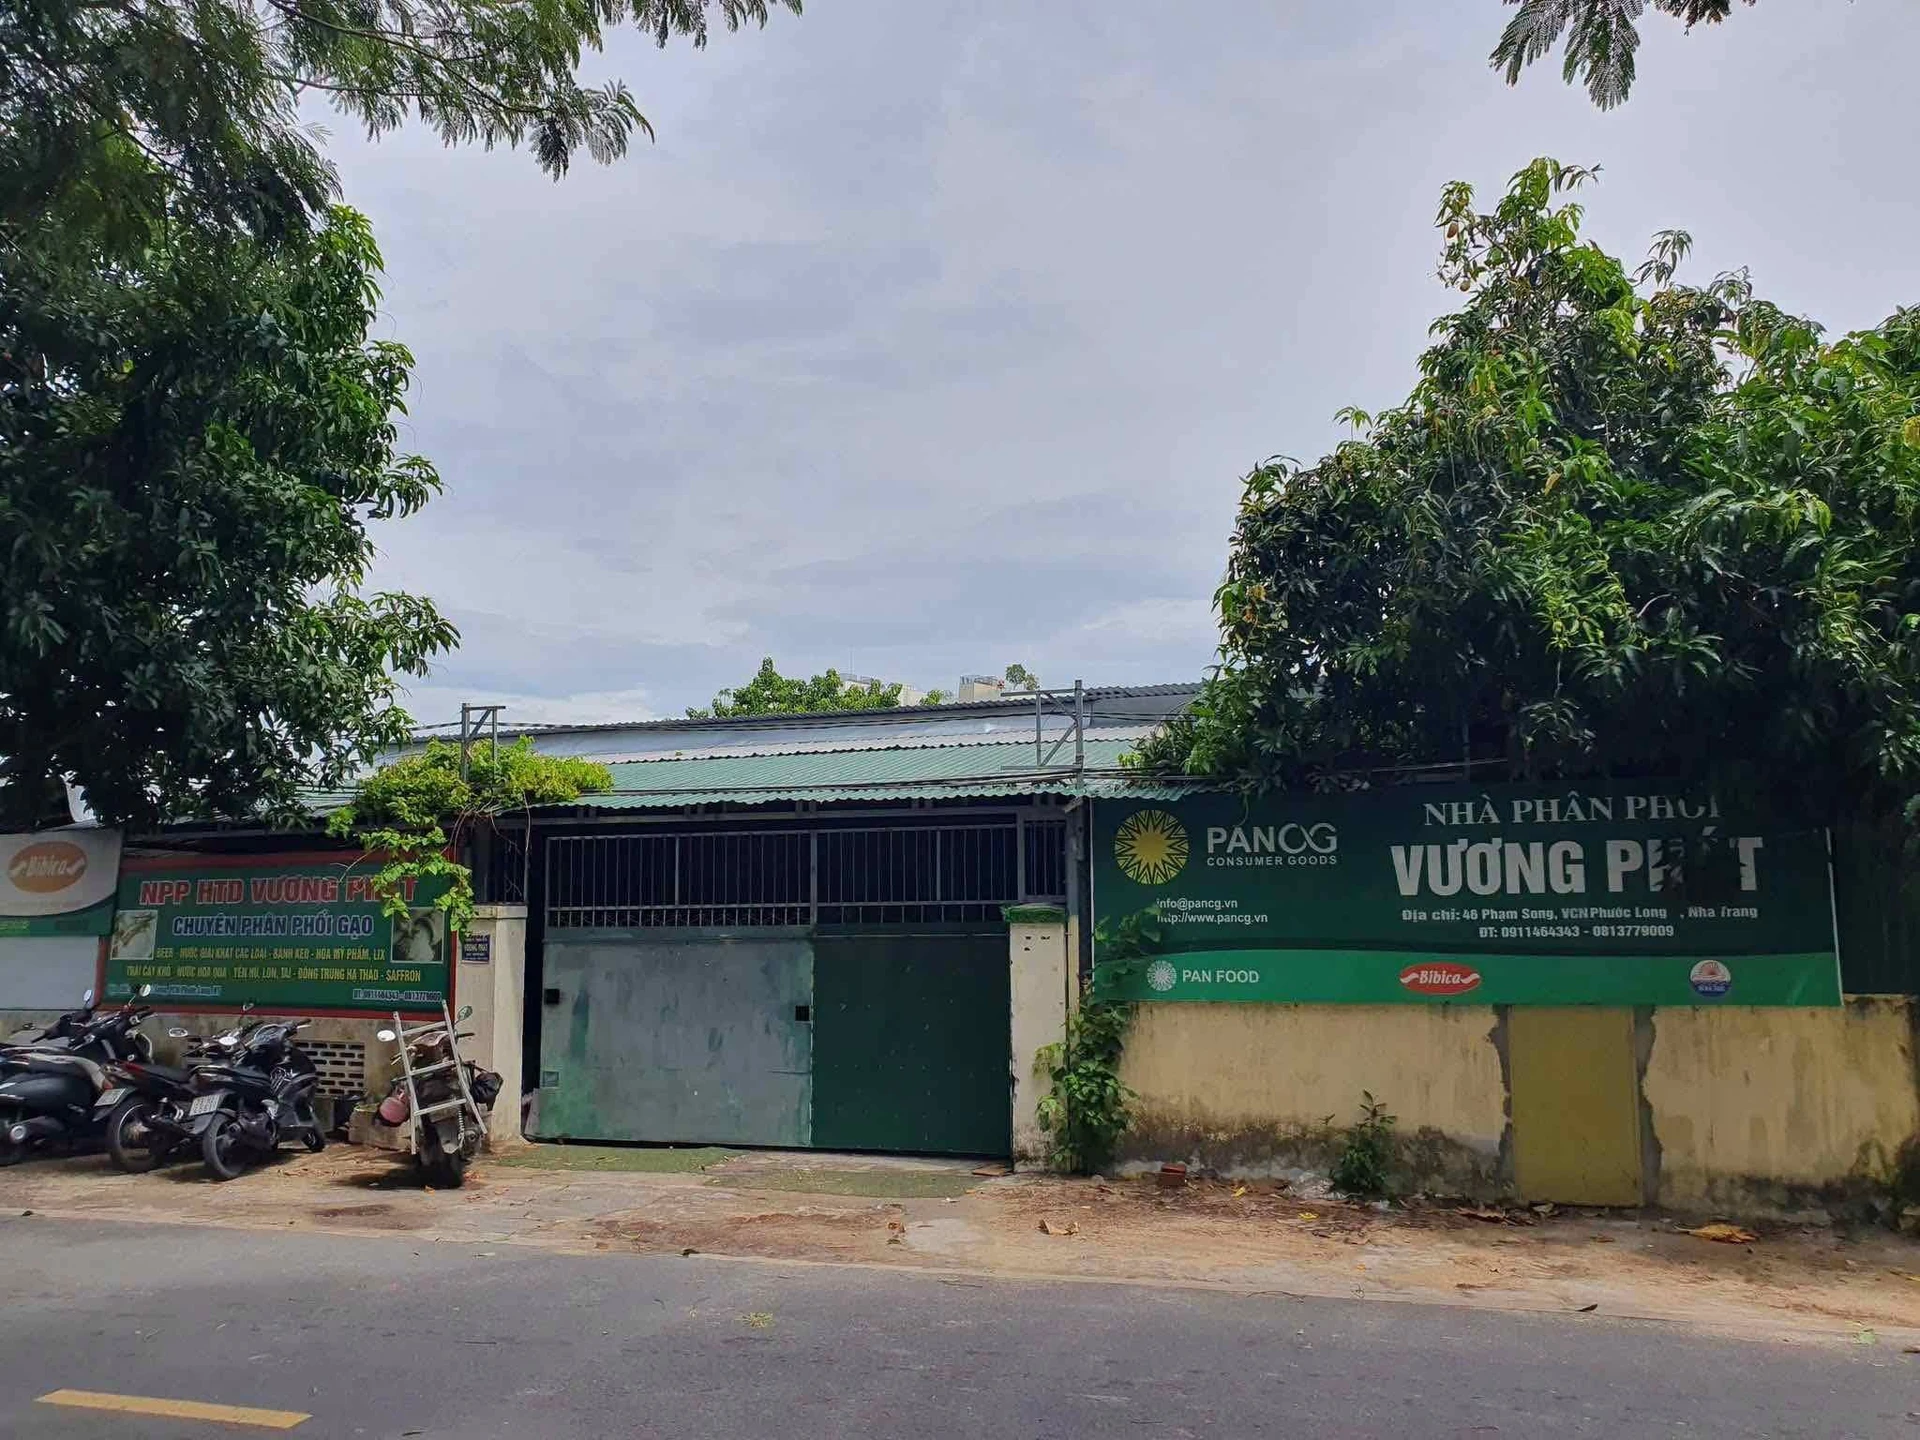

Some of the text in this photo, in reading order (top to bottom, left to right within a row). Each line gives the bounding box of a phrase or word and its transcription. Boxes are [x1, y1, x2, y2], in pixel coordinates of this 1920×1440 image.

[1423, 794, 1500, 825] NHÀ
[1511, 790, 1613, 821] PHÂN
[1207, 855, 1338, 866] CONSUMER GOODS
[1390, 826, 1764, 896] VƯƠNG PHT
[139, 874, 418, 905] NPP HTD VƯƠNG PHT
[1156, 898, 1238, 910] info@pancg.vn
[1402, 909, 1427, 922] Địa
[1481, 908, 1518, 921] Phạm
[1521, 908, 1558, 920] Song,
[1561, 907, 1588, 919] VCN
[1590, 907, 1631, 919] Phước
[1635, 907, 1667, 919] Long
[1688, 906, 1716, 918] Nha
[172, 909, 374, 940] CHUYÊN PHÂN PHỐI GẠO
[1501, 926, 1580, 938] 0911464343
[1593, 925, 1674, 937] 0813779009
[386, 968, 420, 982] SAFFRON
[1182, 969, 1260, 983] PAN FOOD
[1420, 970, 1461, 985] Bibica
